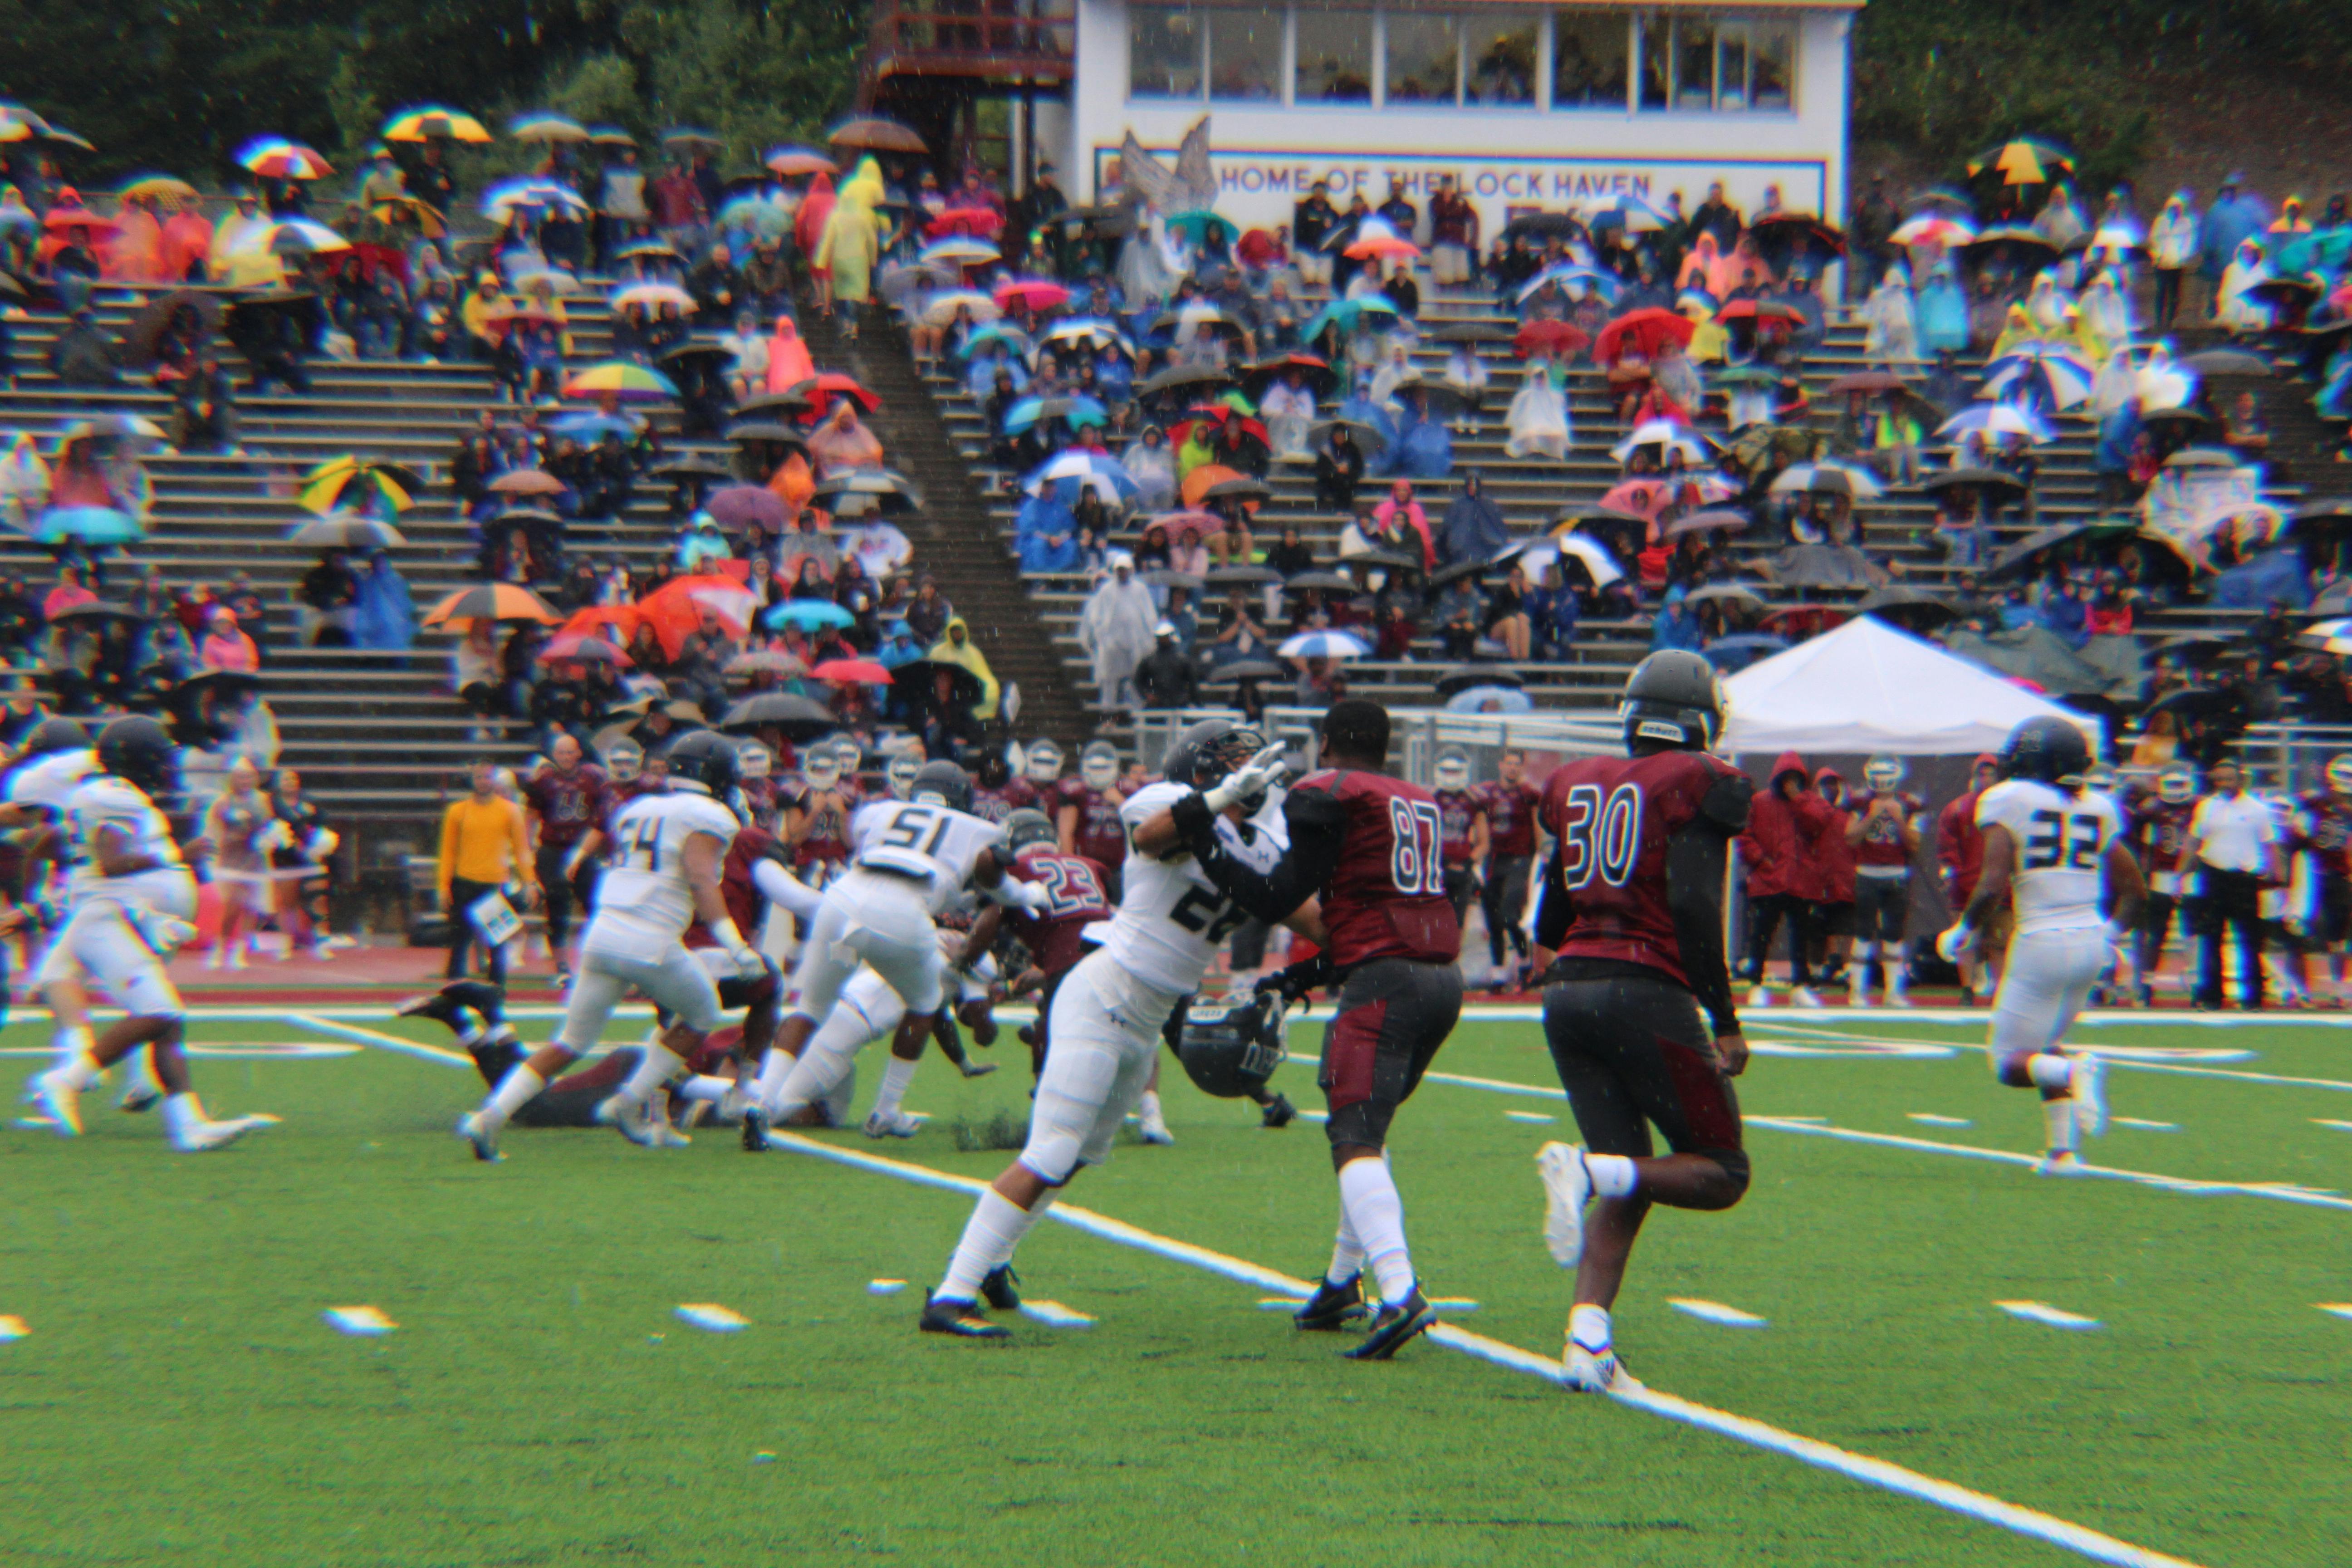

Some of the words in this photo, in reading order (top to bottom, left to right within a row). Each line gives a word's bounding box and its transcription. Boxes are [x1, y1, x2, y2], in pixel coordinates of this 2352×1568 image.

[1221, 167, 1310, 193] HOME
[1327, 169, 1370, 194] OF
[1382, 171, 1443, 196] THE
[1454, 172, 1543, 198] LOCK
[1553, 173, 1651, 199] HAVEN
[882, 807, 952, 858] 51
[1389, 794, 1443, 894] 87
[1564, 781, 1641, 890] 30
[2025, 808, 2100, 870] 32
[1026, 857, 1104, 916] 23
